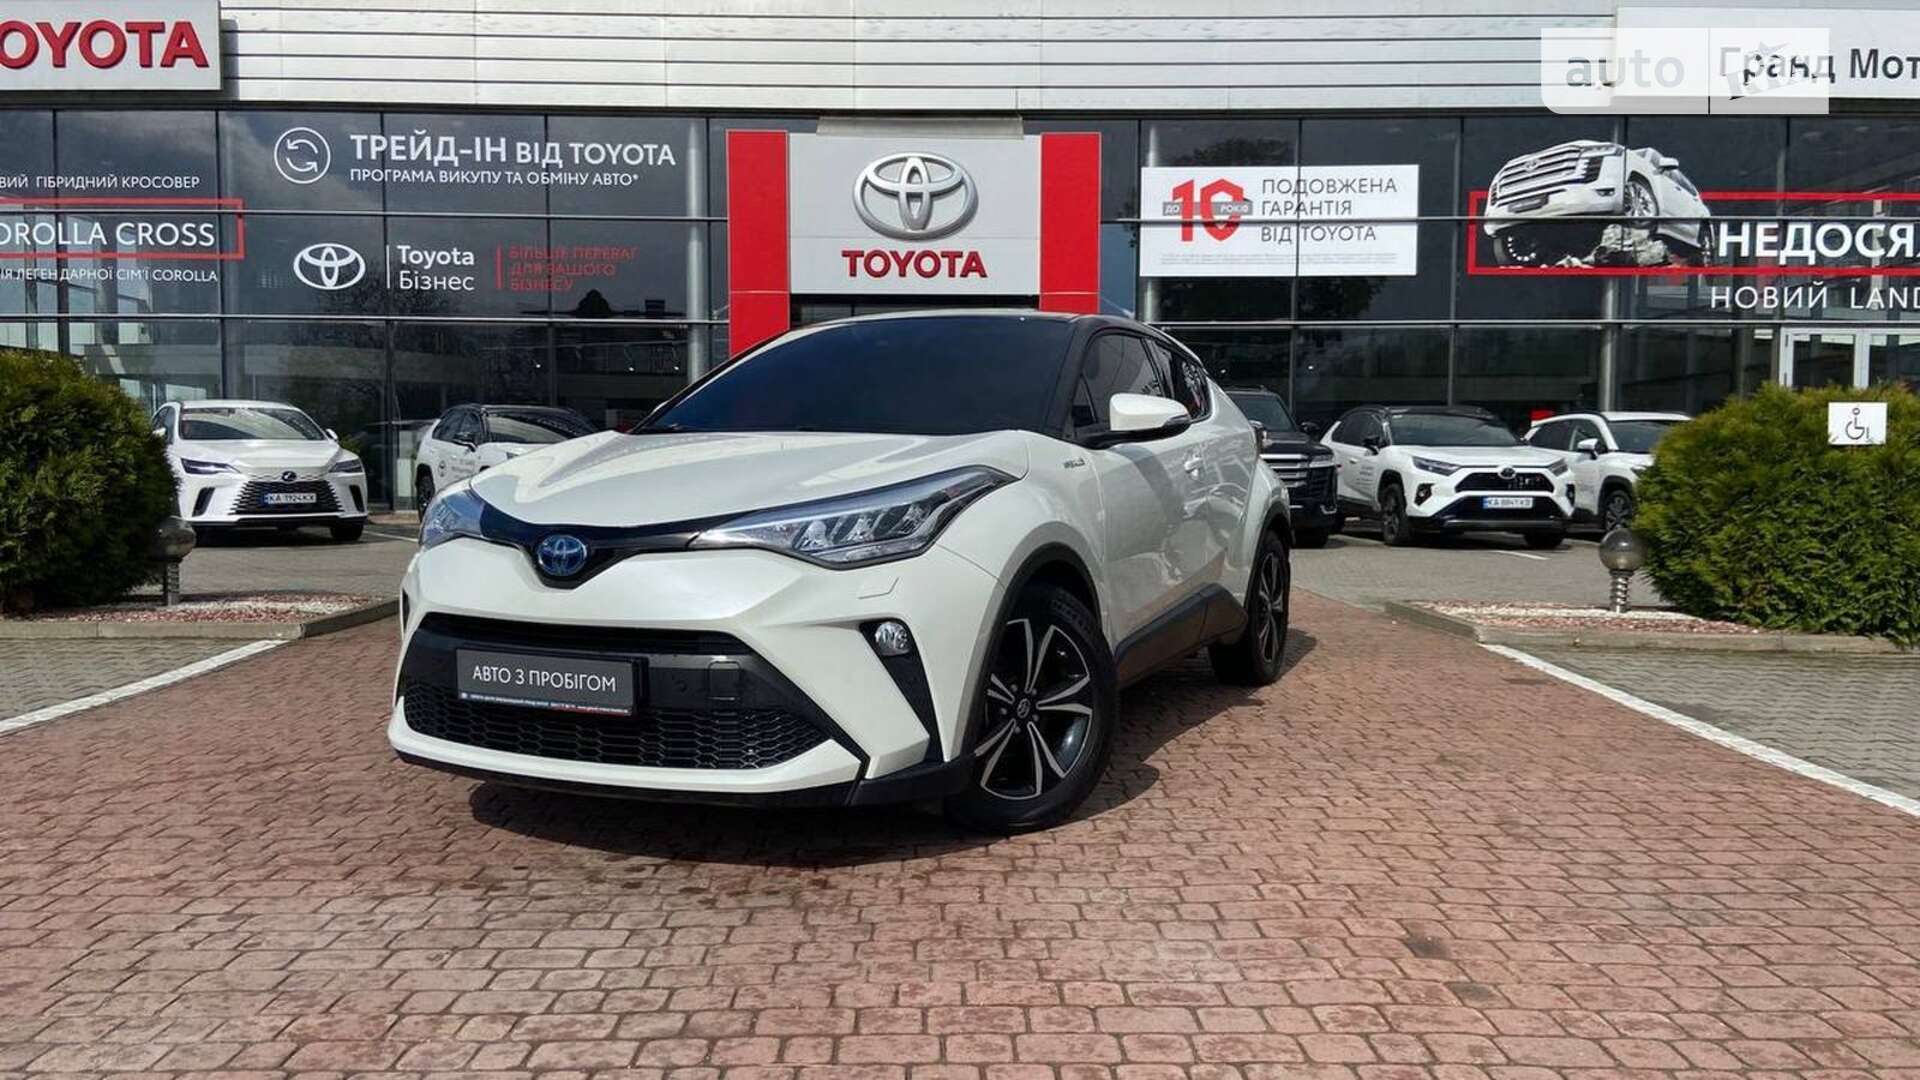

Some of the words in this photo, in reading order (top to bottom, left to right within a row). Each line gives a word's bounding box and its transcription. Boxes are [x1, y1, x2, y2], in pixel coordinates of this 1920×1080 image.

[1720, 47, 1836, 86] Гранд
[350, 129, 507, 167] ТРЕЙД-ІН
[516, 142, 563, 168] ВІД
[569, 143, 676, 166] TOYOTA
[36, 174, 118, 190] ГІБРИДНИЙ
[122, 176, 200, 189] КРОСОВЕР
[350, 169, 435, 183] ПРОГРАМА
[439, 171, 501, 184] ВИКУПУ
[504, 171, 523, 185] ТА
[527, 171, 589, 186] ОБМІНУ
[1262, 178, 1398, 197] ПОДОВЖЕНА
[1173, 178, 1244, 241] 10
[1262, 200, 1352, 216] ГАРАНТІЯ
[116, 222, 215, 247] CROSS
[1261, 226, 1292, 244] ВІД
[1301, 225, 1377, 241] TOYOTA
[1718, 222, 1920, 265] НЕДОСЯ
[397, 245, 475, 269] Toyota
[842, 249, 987, 278] TOYOTA
[152, 269, 218, 282] COROLLA
[400, 271, 475, 291] Бізнес
[1711, 281, 1827, 309] НОВИЙ
[472, 665, 511, 684] АВТО
[529, 670, 616, 692] ПРОБІГОМ
